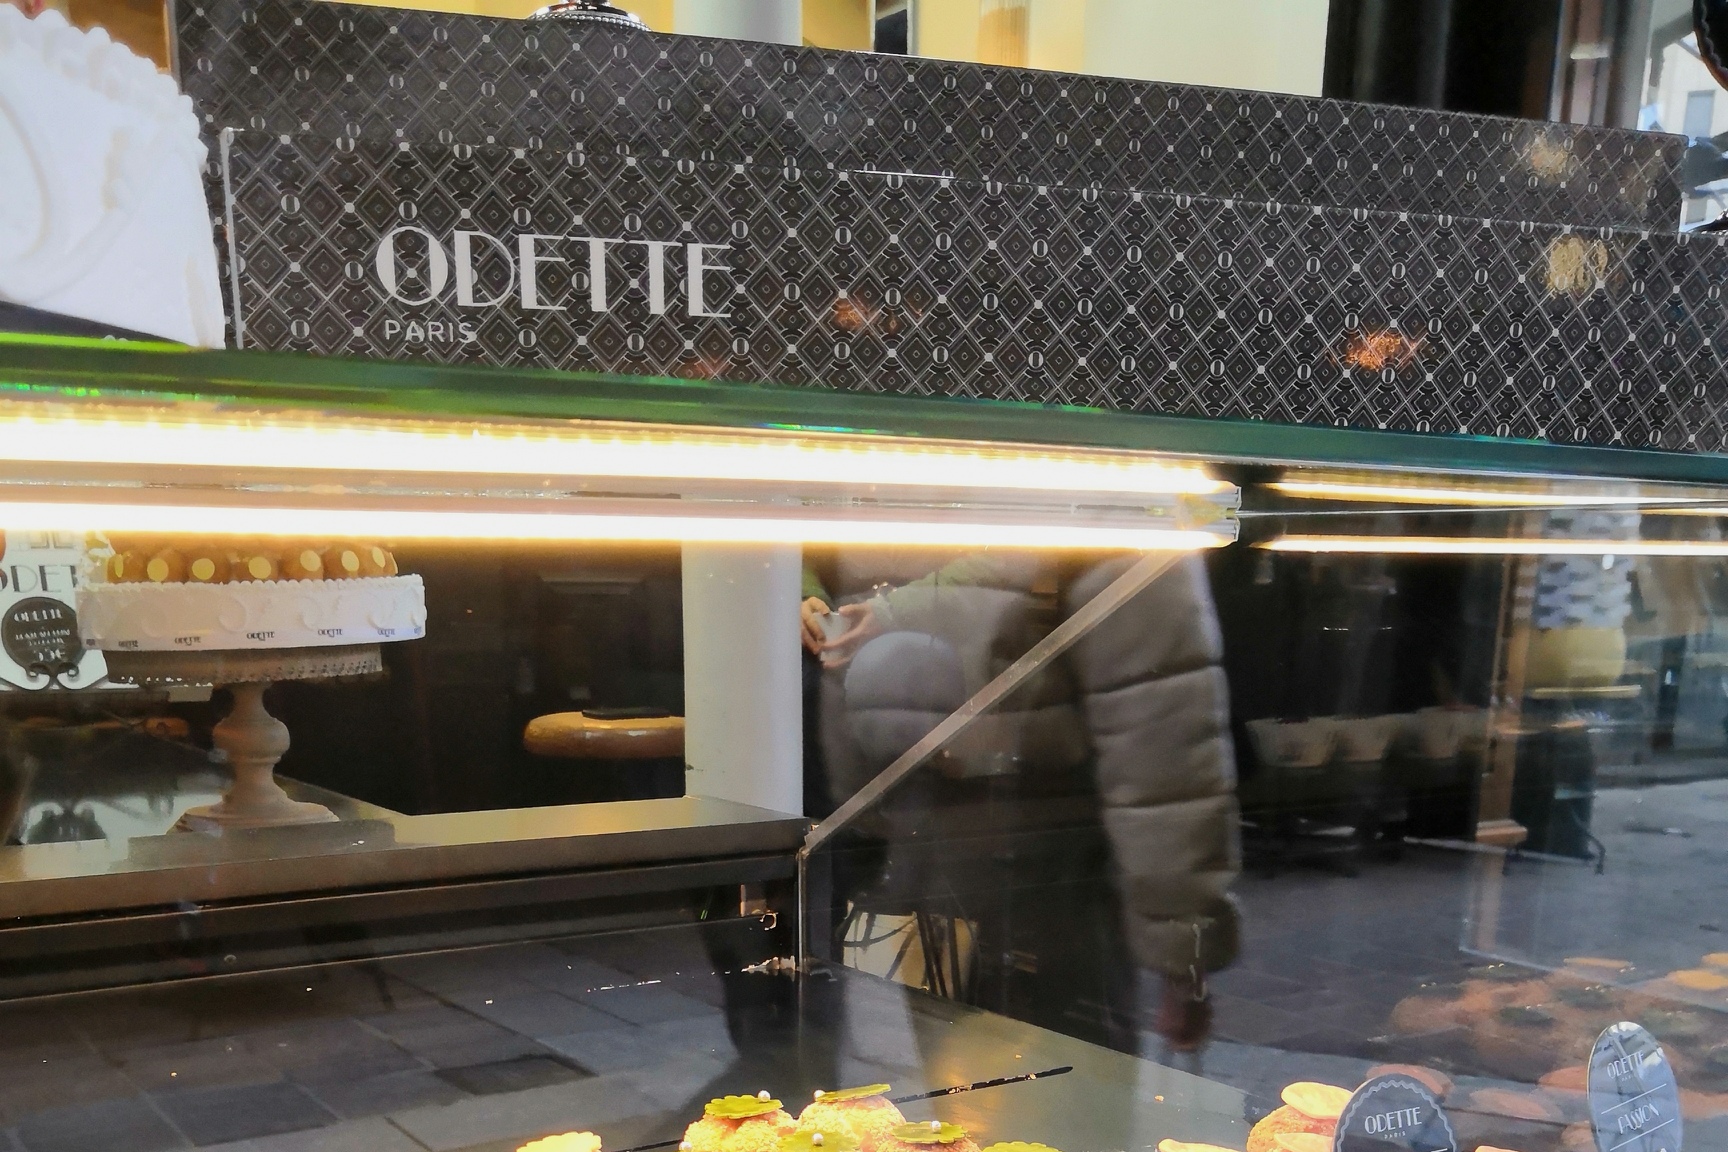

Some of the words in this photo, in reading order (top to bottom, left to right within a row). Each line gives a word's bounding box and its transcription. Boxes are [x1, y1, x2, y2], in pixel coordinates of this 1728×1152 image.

[375, 226, 731, 318] ODETTE
[384, 319, 474, 344] PARIS
[1364, 1106, 1422, 1134] ODETTE
